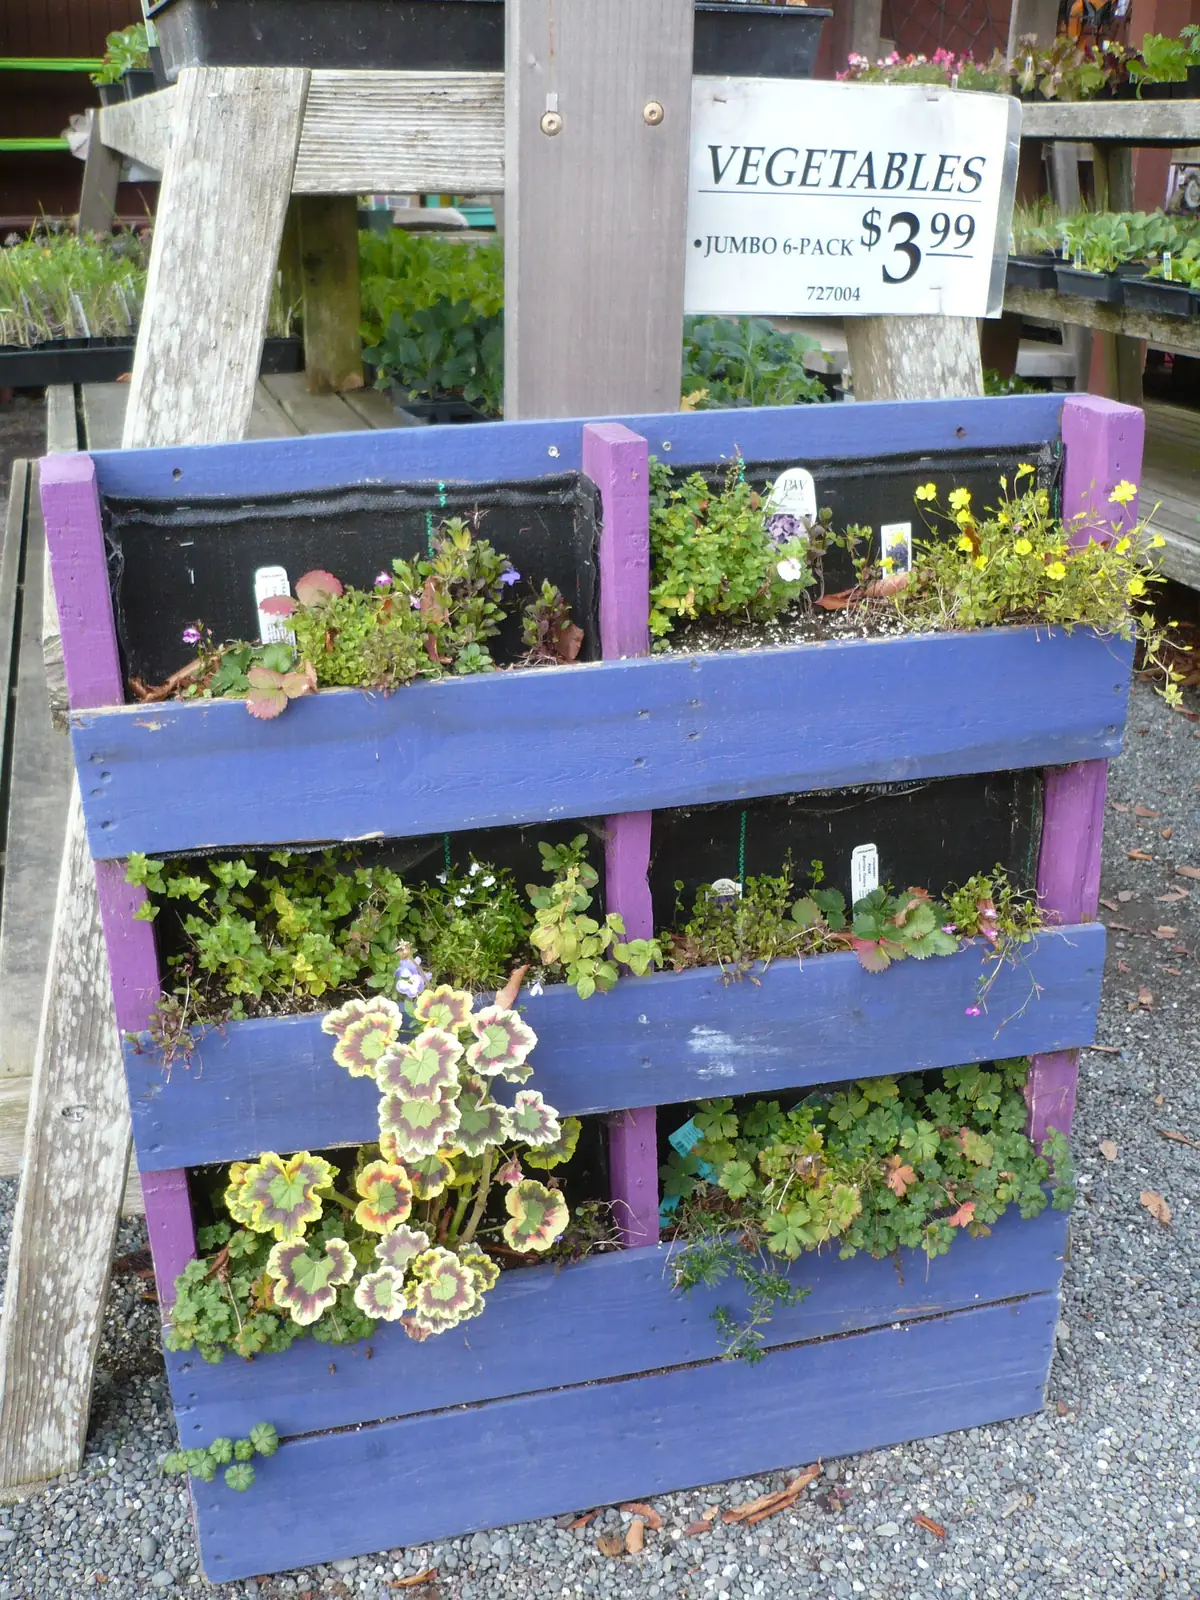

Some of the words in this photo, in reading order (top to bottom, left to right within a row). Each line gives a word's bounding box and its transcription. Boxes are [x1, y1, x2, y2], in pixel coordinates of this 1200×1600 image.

[707, 144, 987, 194] VEGETABLES
[703, 235, 778, 258] JUMBO
[782, 238, 855, 257] 6-PACK
[806, 286, 861, 302] 727004
